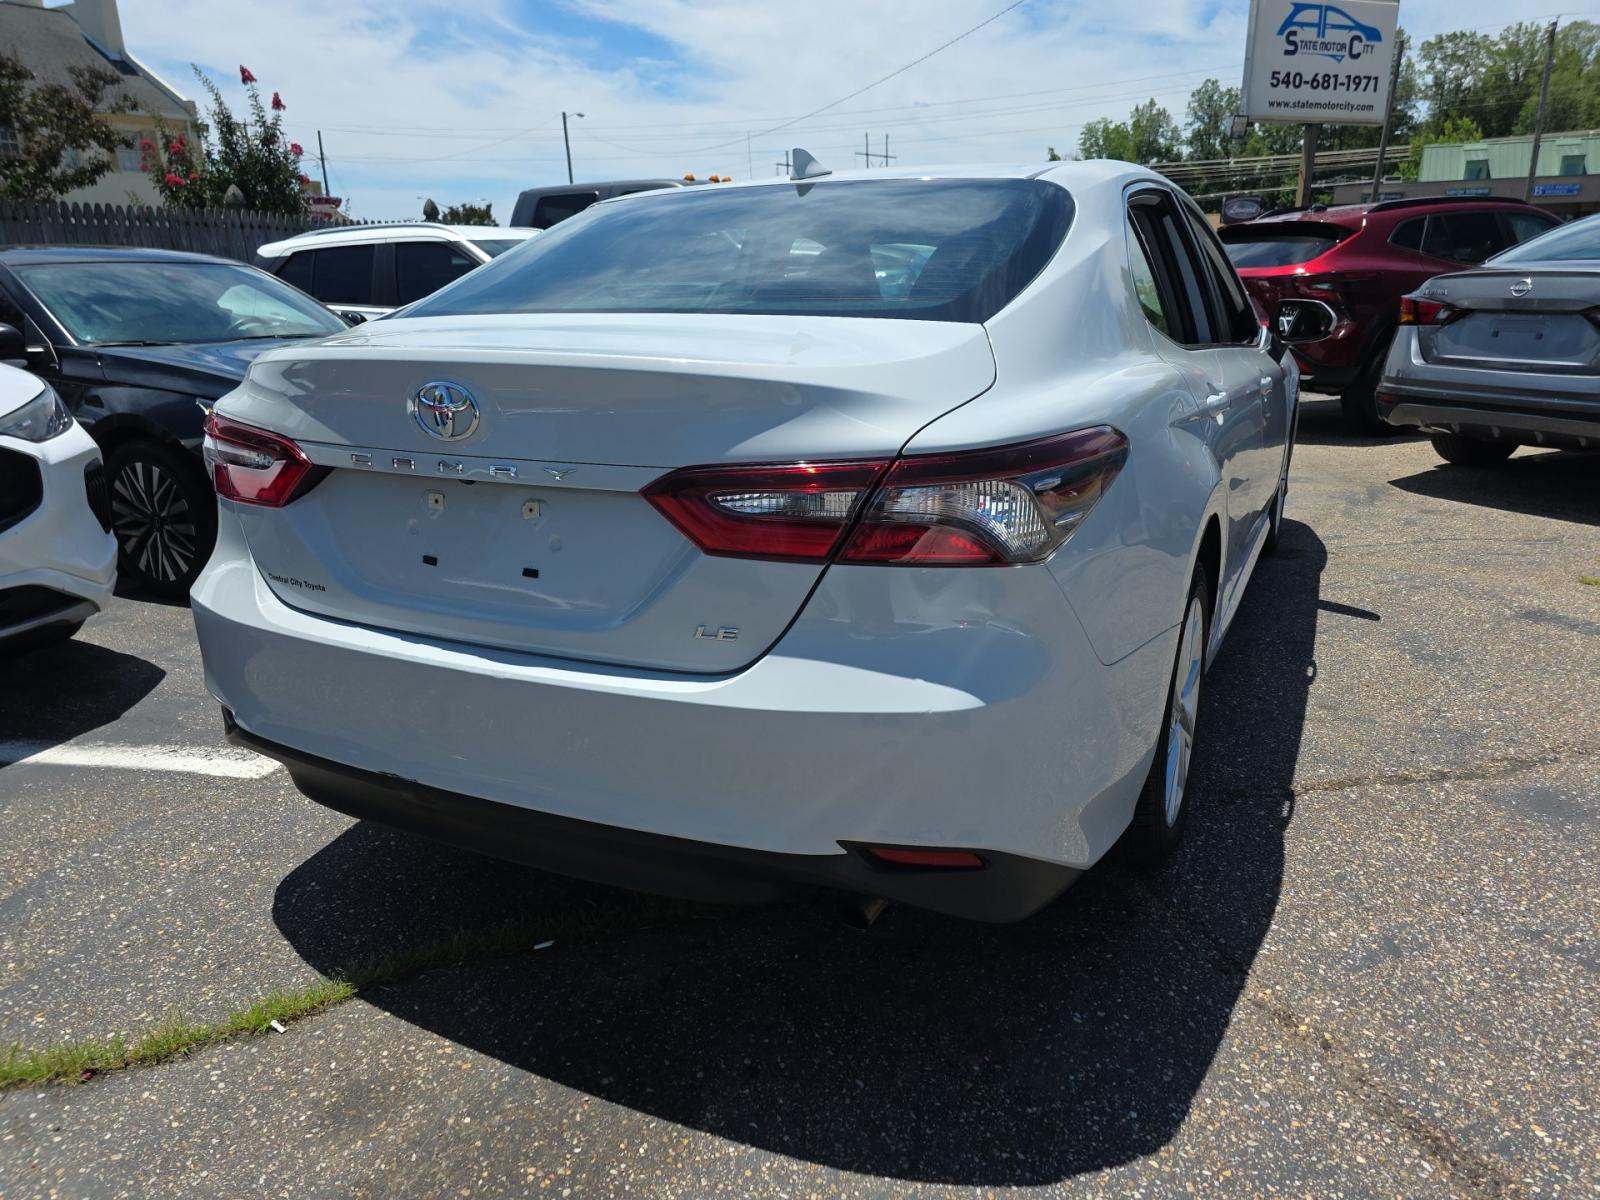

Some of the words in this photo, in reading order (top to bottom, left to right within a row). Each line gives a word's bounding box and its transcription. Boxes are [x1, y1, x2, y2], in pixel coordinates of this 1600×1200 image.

[1284, 30, 1318, 56] STATE
[1319, 41, 1347, 53] MOTOR
[1348, 35, 1375, 60] CITY
[1270, 71, 1379, 93] 540-681-1971
[1268, 99, 1374, 112] www.statemotorcity.com
[351, 453, 577, 481] CAMRY
[268, 572, 289, 584] Central
[290, 577, 303, 588] City
[303, 580, 326, 592] Toyota
[694, 624, 738, 641] LE
